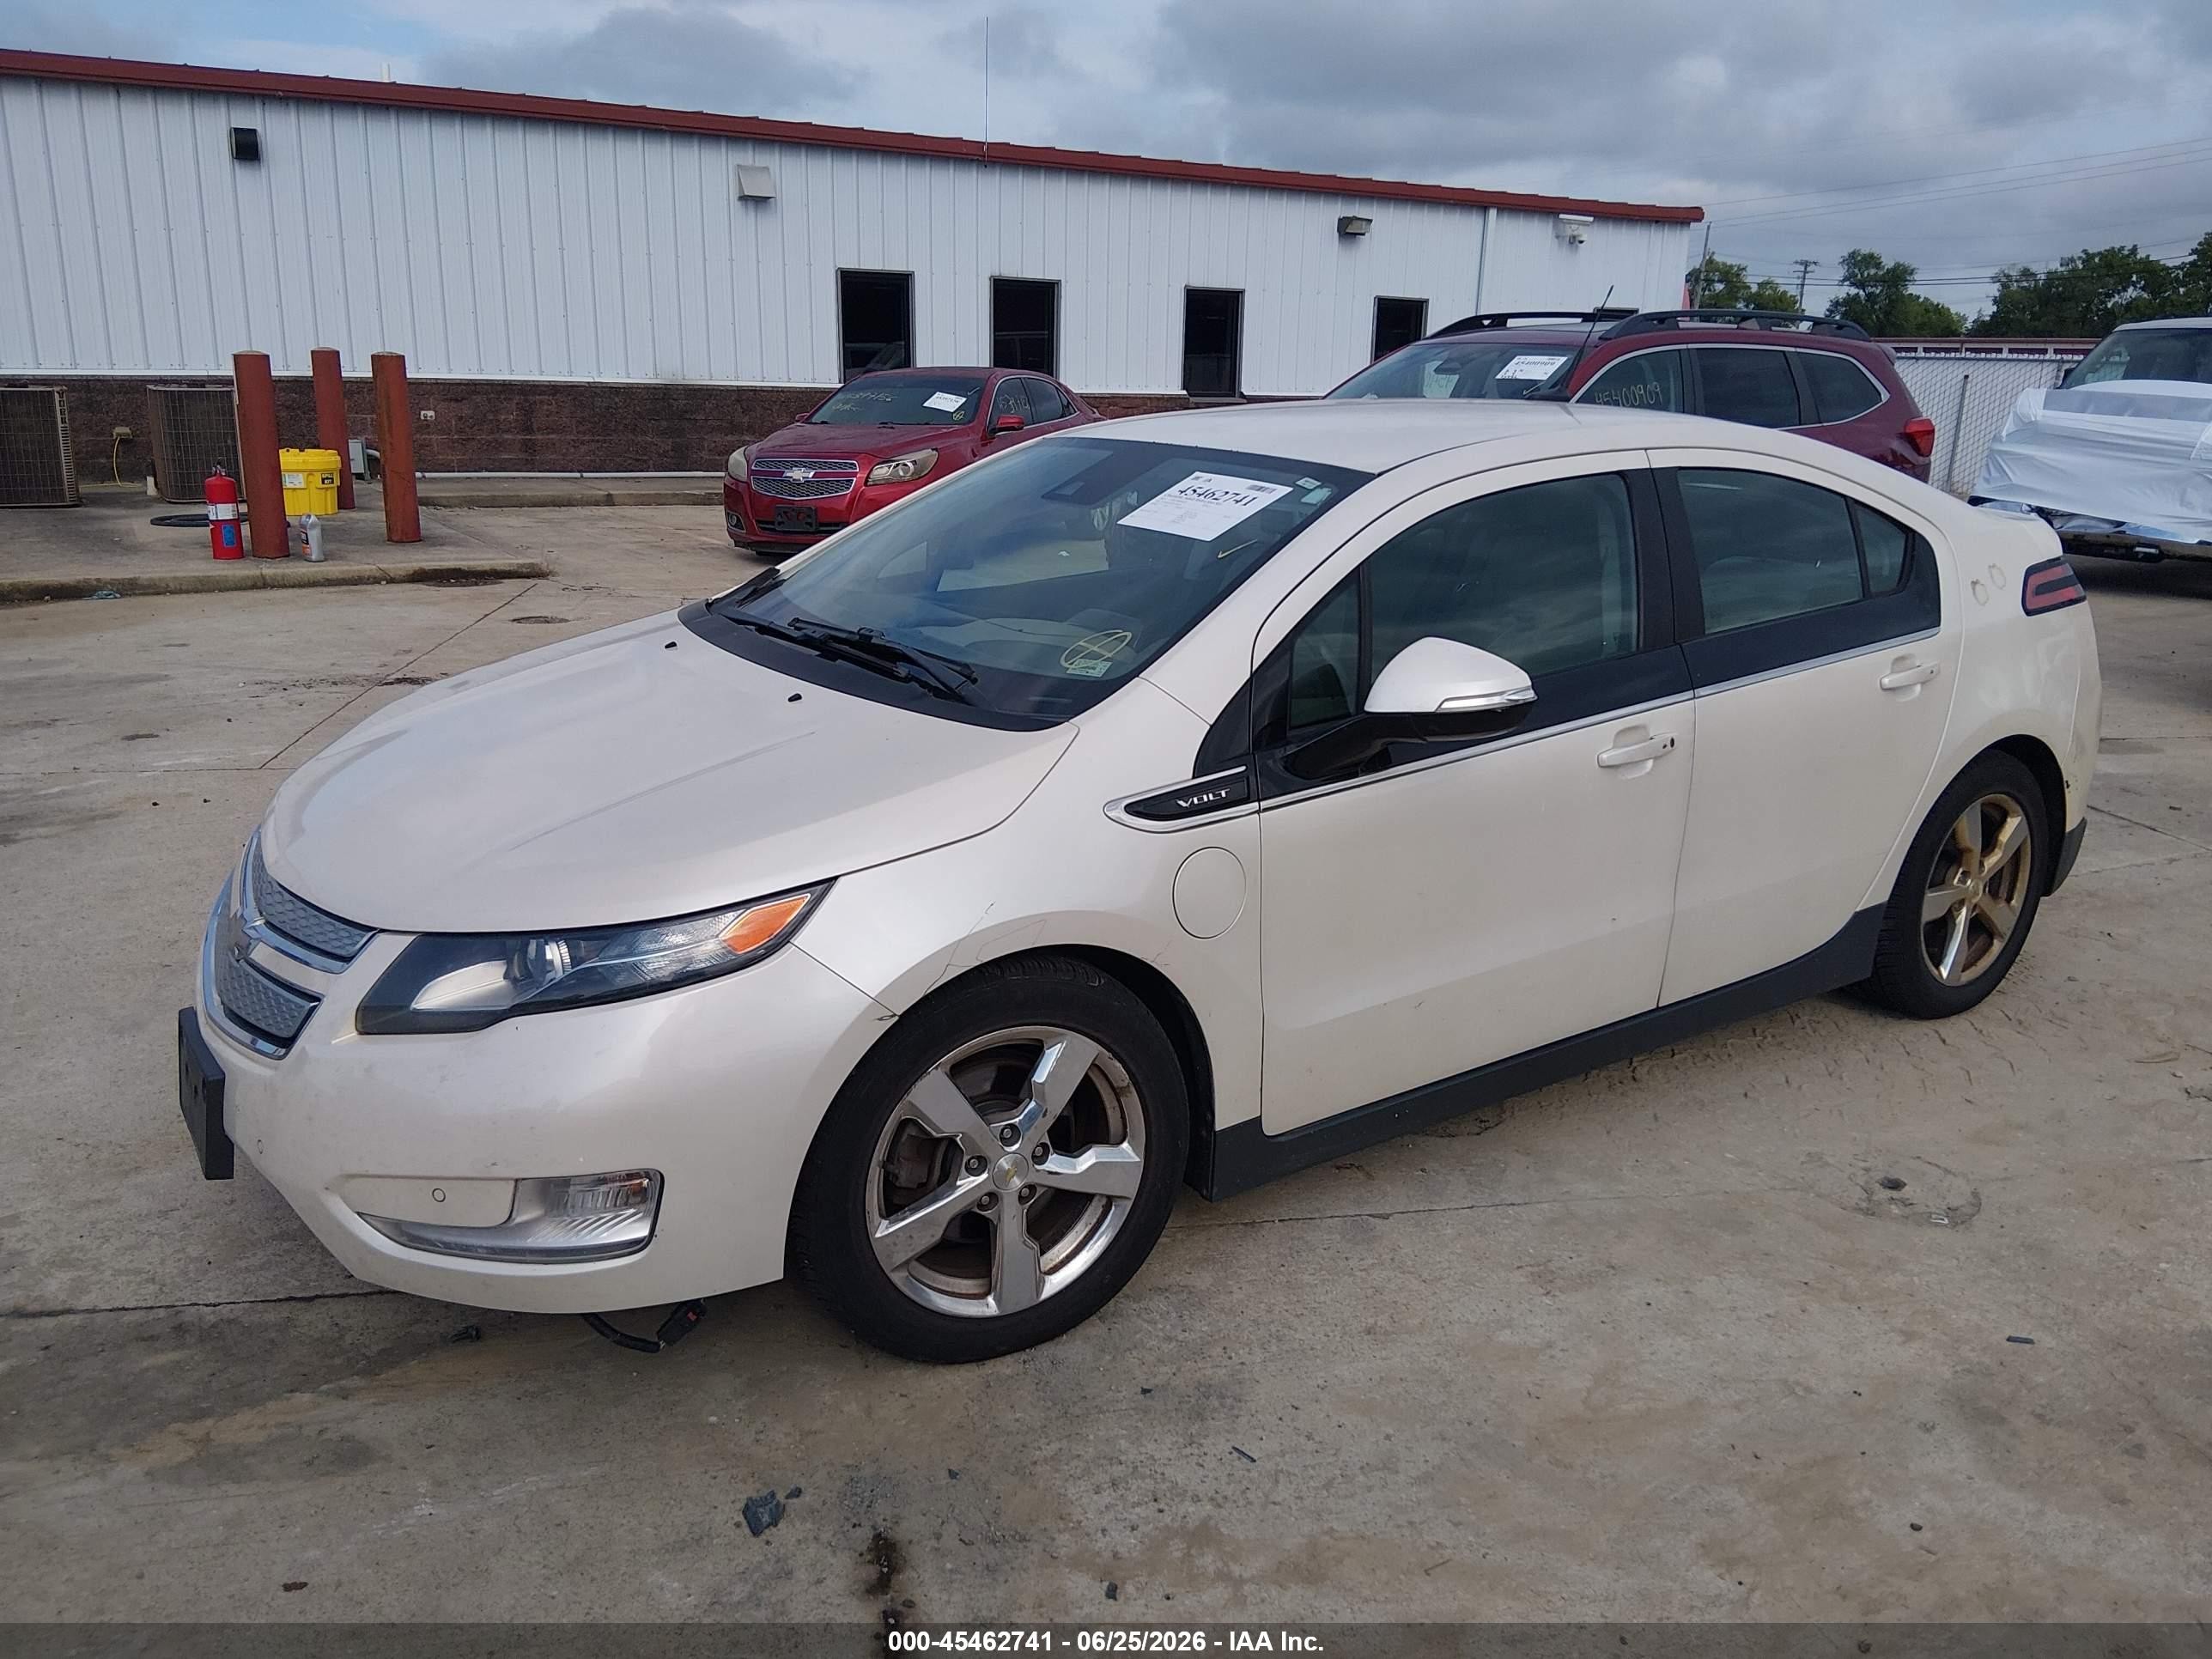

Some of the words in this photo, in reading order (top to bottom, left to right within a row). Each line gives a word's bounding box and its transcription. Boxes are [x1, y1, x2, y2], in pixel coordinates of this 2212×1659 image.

[1595, 382, 1662, 406] 45400909
[1178, 485, 1258, 506] 45462741
[1175, 788, 1231, 808] VOLT
